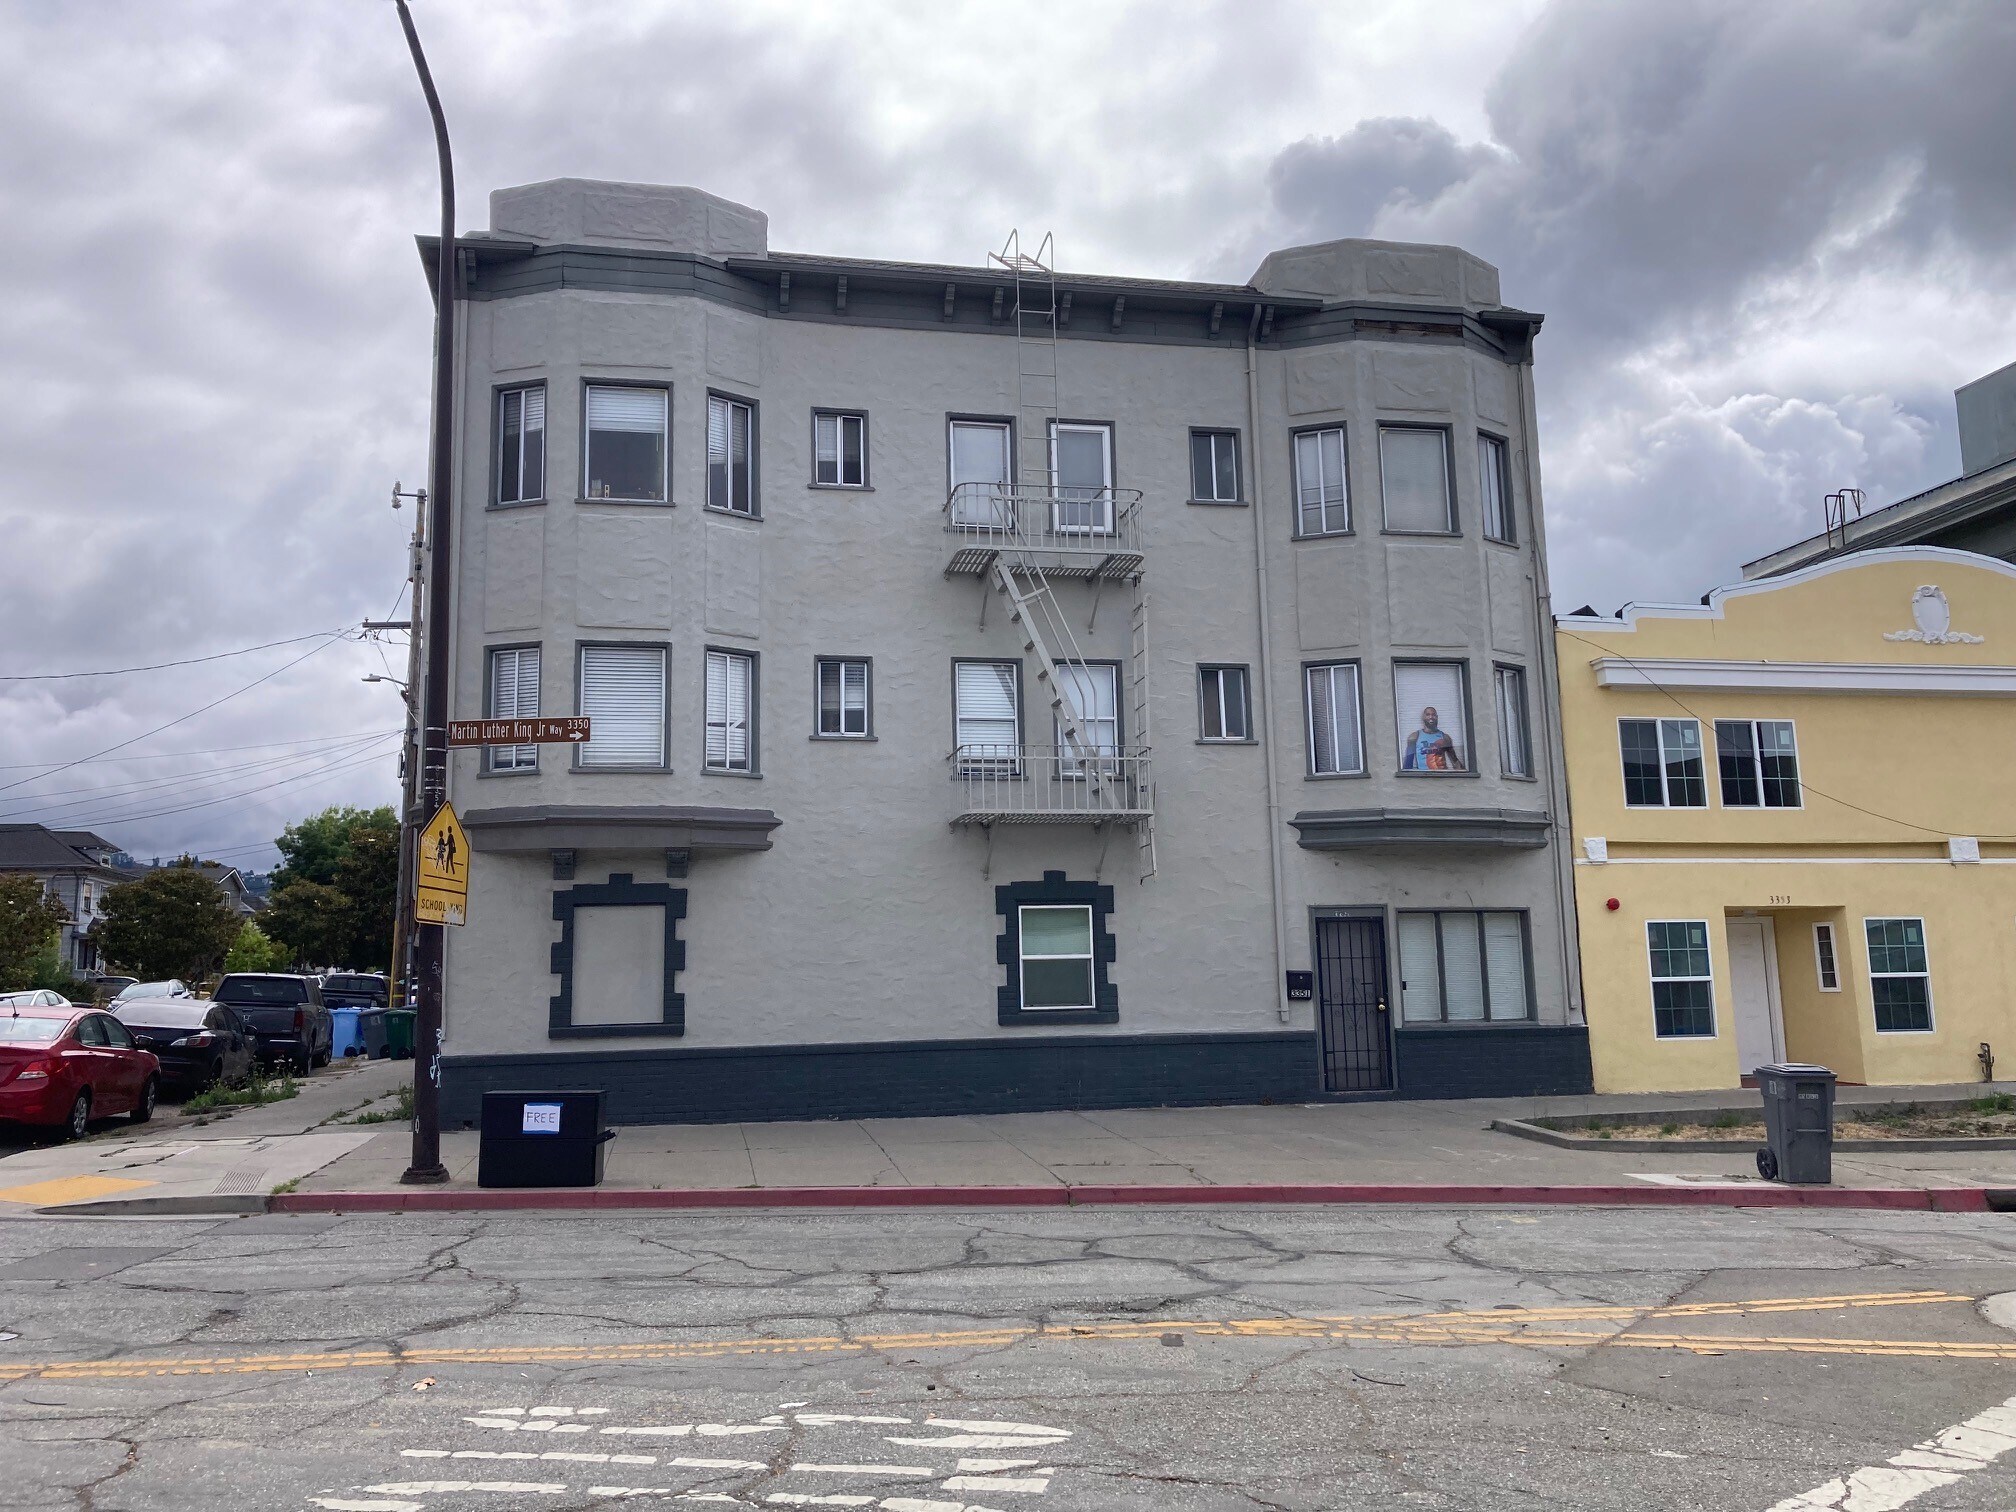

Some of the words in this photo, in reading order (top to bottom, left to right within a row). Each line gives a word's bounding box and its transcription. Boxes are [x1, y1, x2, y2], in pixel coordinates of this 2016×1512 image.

[451, 723, 478, 739] Martin
[482, 722, 510, 739] Luther
[514, 721, 532, 741] King
[536, 720, 545, 737] Jr
[549, 724, 563, 737] Way
[567, 719, 589, 730] 3350
[421, 899, 447, 912] SCHOOL
[526, 1111, 556, 1124] FREE
